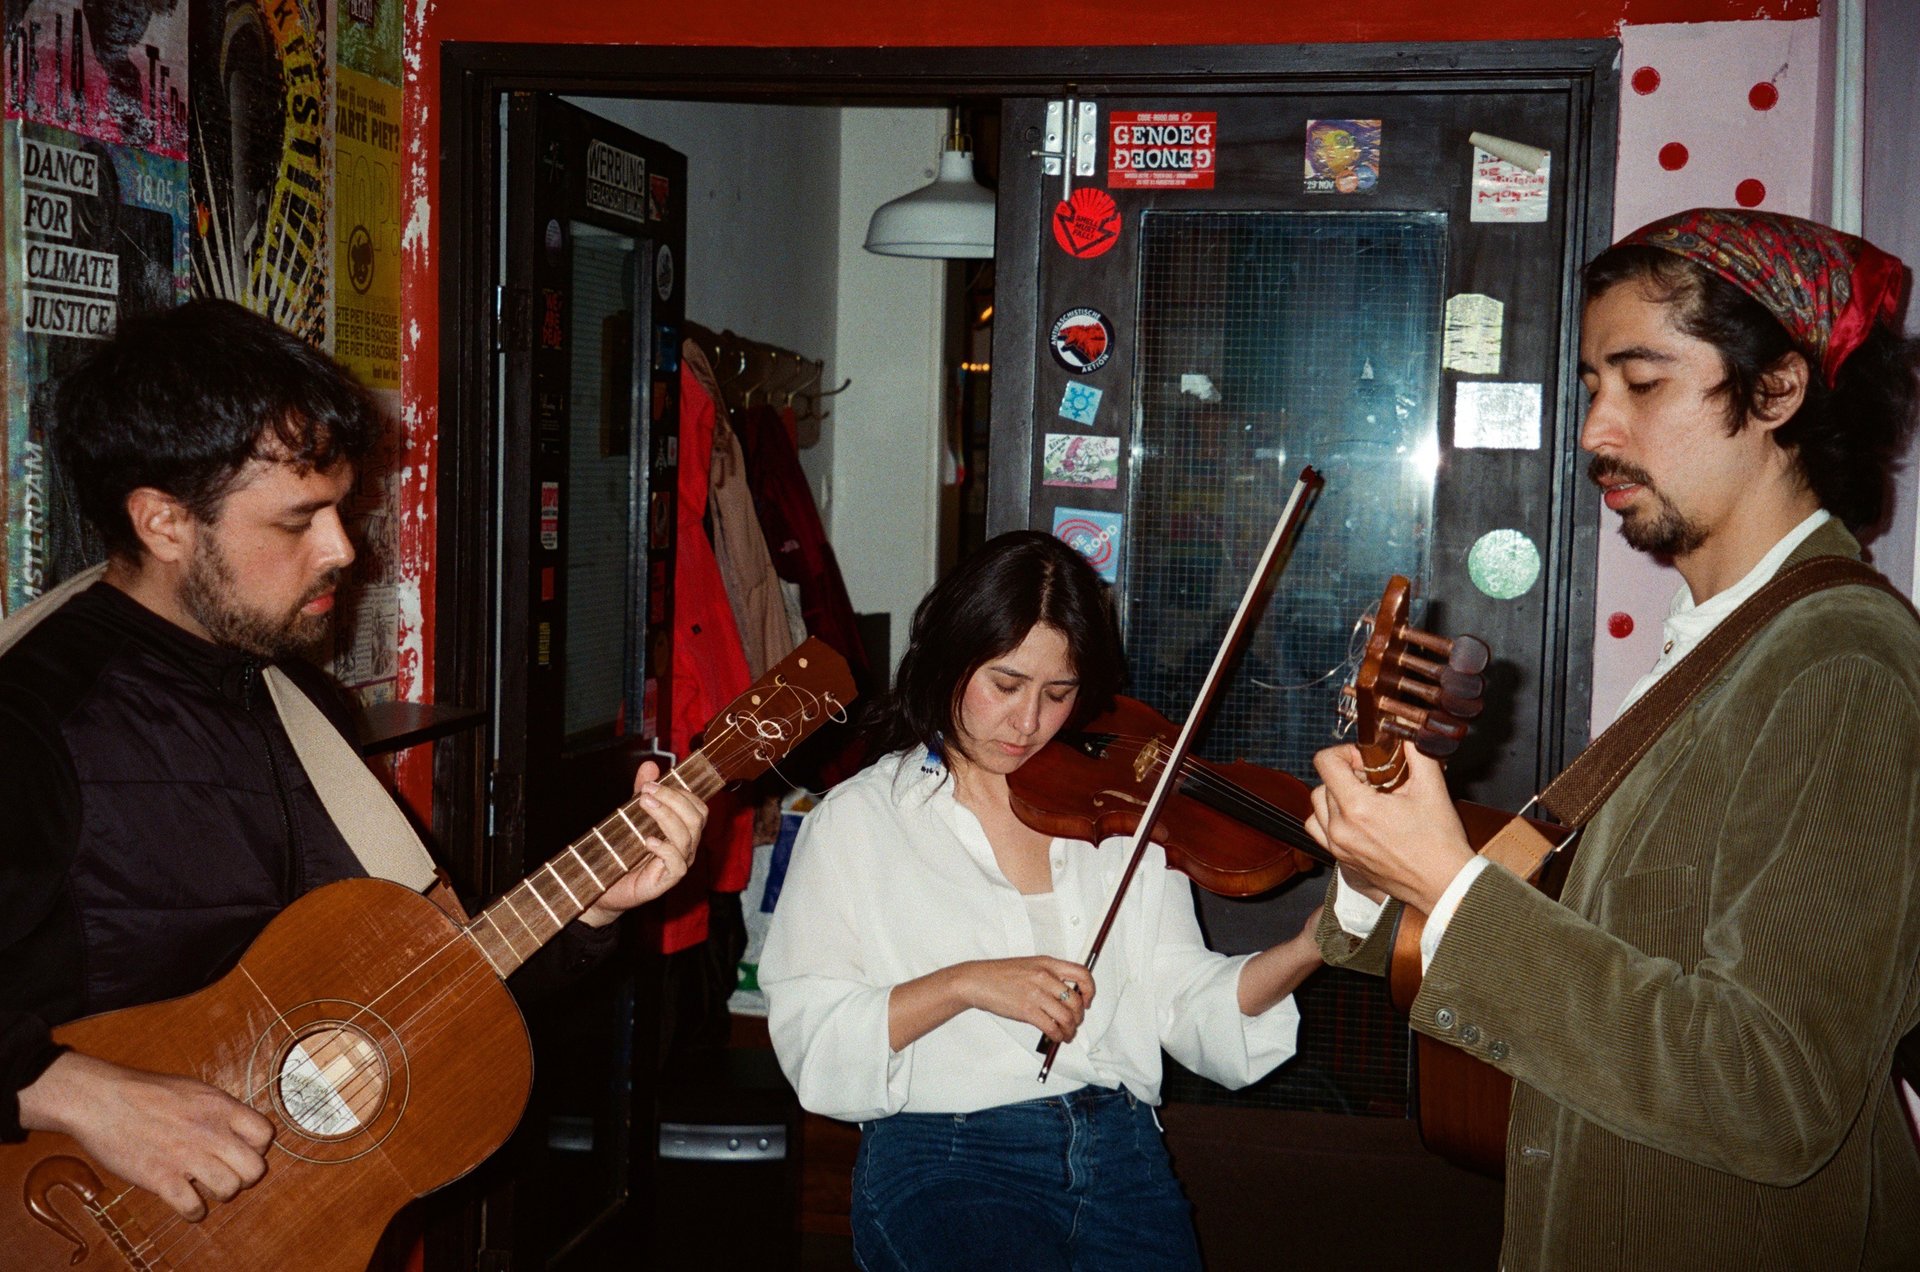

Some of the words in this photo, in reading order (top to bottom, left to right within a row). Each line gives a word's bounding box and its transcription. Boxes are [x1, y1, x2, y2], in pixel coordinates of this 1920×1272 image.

[369, 97, 386, 117] steeds
[336, 105, 367, 143] ARTE
[371, 117, 400, 153] PIET?
[1113, 125, 1212, 145] GENOEG
[25, 144, 95, 189] DANCE
[588, 142, 645, 193] WERBUNG
[1113, 148, 1212, 169] GENOEG
[135, 174, 175, 208] 18.05
[336, 149, 399, 256] TOP!
[25, 195, 68, 233] FOR
[1075, 222, 1096, 234] MUST
[1076, 215, 1097, 226] SHELL
[27, 246, 113, 289] CLIMATE
[26, 297, 110, 336] JUSTICE
[336, 306, 349, 321] RTE
[1051, 308, 1101, 345] ANTIFASCHISTISCHE
[336, 323, 349, 338] RTE
[336, 339, 349, 355] RTE
[1081, 354, 1109, 373] AKTION
[24, 440, 44, 599] MSTERDAM
[1084, 524, 1118, 554] ROOD
